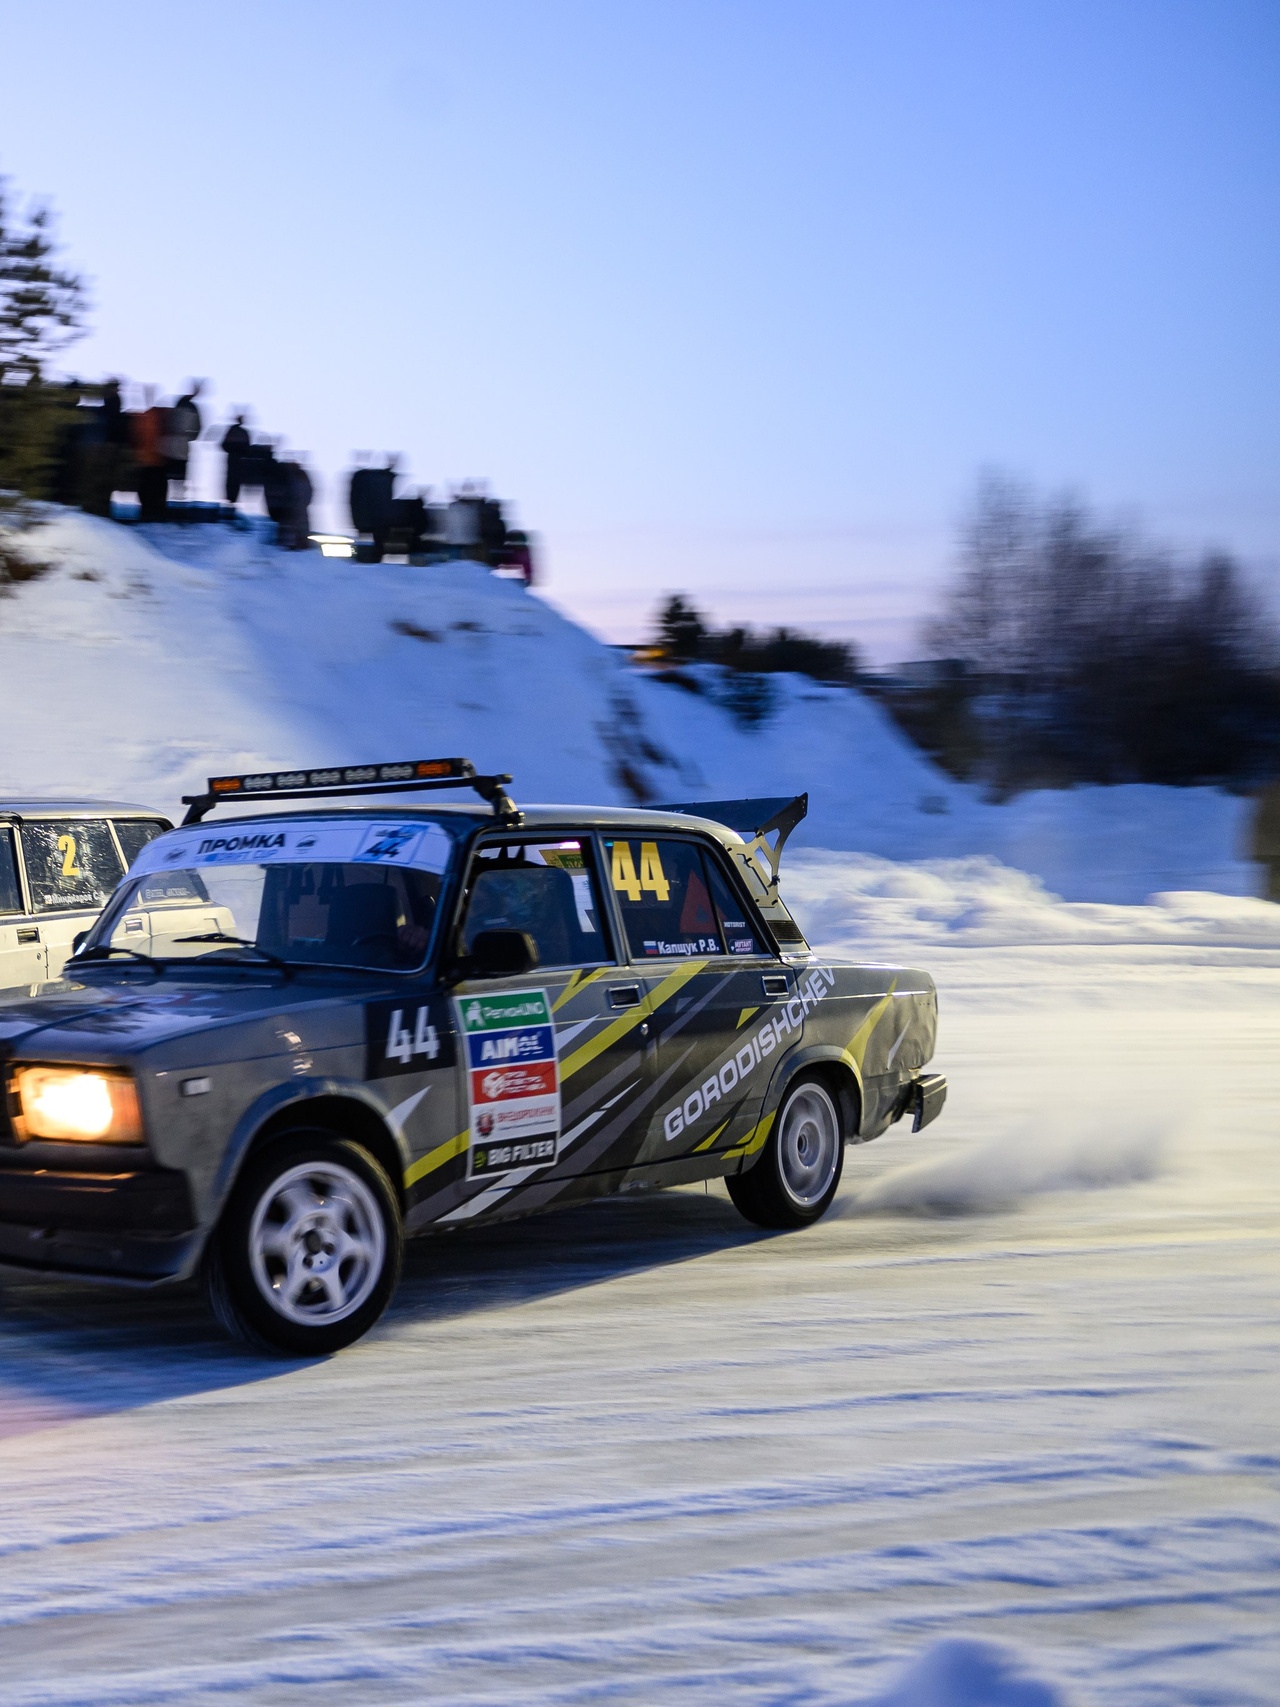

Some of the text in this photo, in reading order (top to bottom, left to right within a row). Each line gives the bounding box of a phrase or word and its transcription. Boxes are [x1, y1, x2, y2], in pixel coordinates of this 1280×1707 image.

[57, 835, 79, 876] 2
[198, 833, 286, 854] ПРОМКА
[612, 841, 670, 901] 44
[657, 941, 698, 956] Капщук
[698, 938, 720, 952] Р.В.
[385, 1005, 441, 1065] 44
[663, 964, 836, 1141] GORODISHCHEV
[487, 1139, 555, 1166] BIG FILTER
